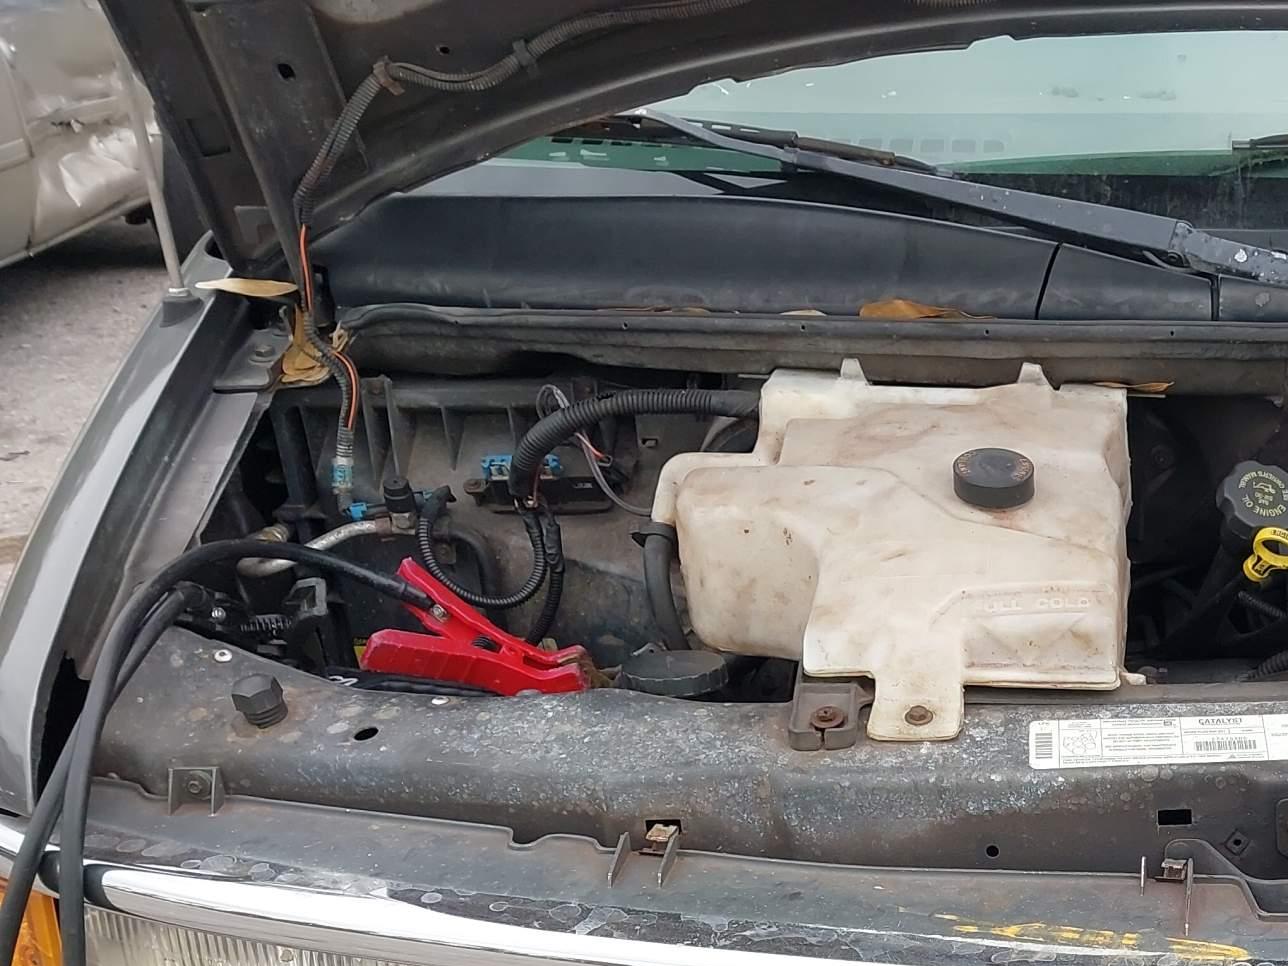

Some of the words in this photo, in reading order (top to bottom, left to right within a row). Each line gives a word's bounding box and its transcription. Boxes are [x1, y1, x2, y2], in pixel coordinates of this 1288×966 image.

[1242, 494, 1254, 507] OIL
[1254, 504, 1286, 516] ENGINE
[974, 597, 1021, 612] ULL
